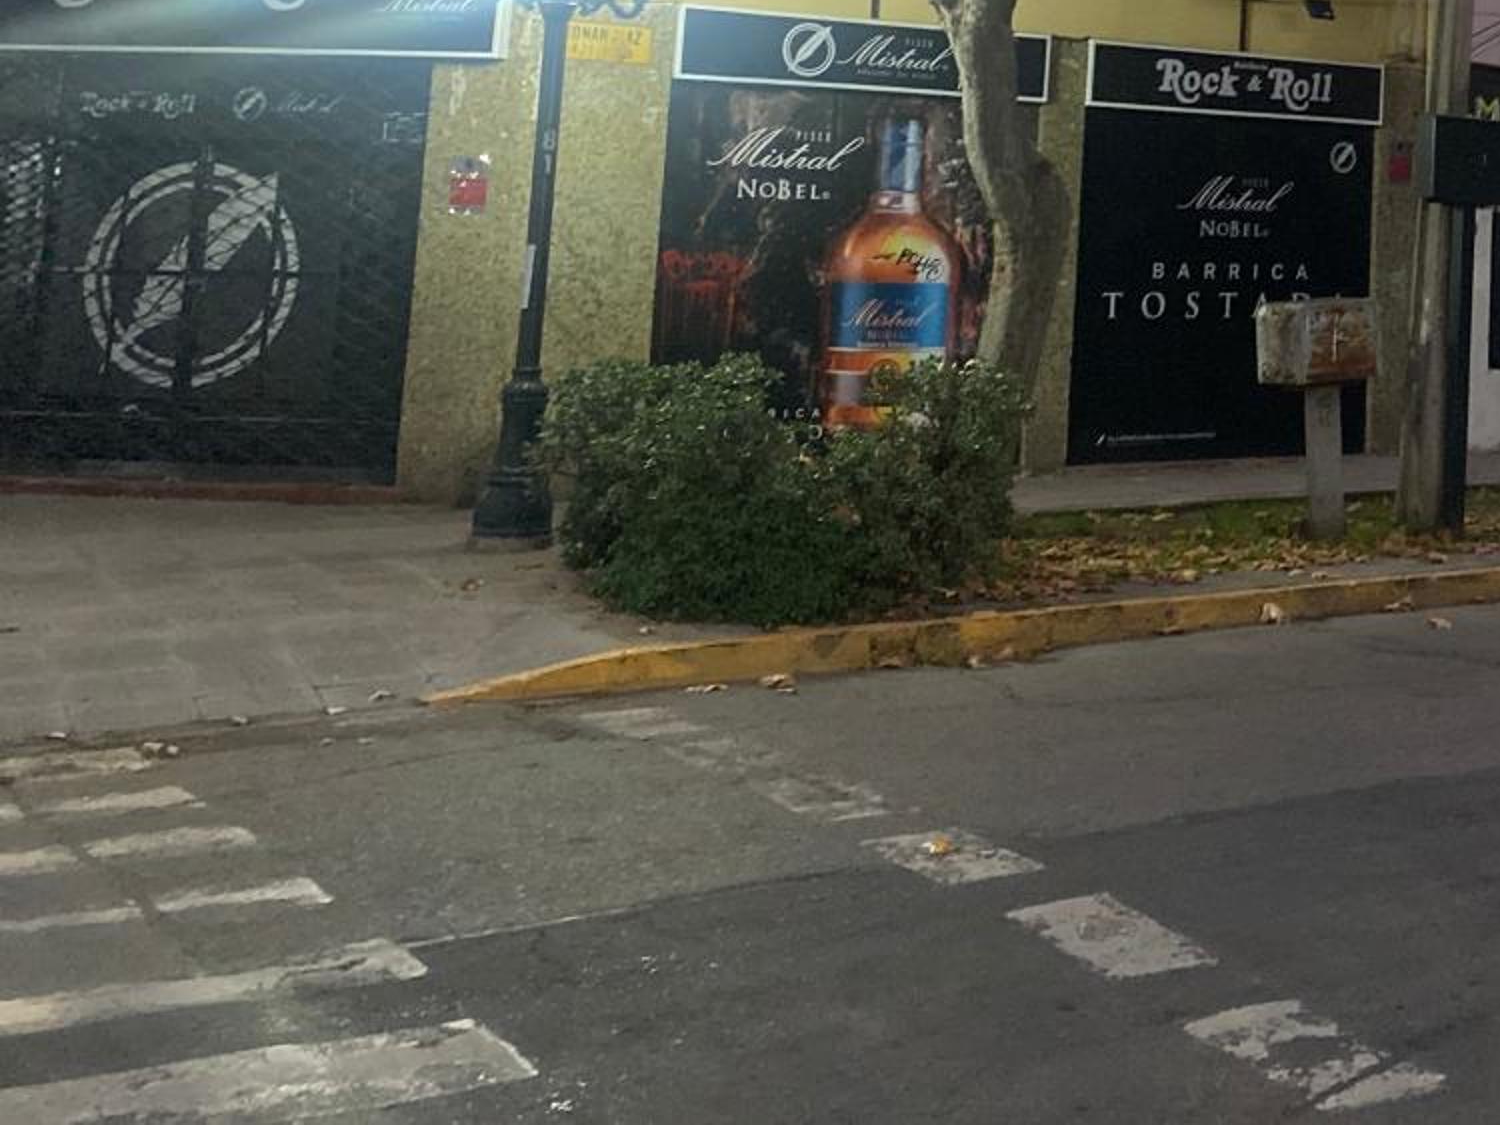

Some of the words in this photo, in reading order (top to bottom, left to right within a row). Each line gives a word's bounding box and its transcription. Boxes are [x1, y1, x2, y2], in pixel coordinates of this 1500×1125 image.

[836, 34, 953, 71] Mistral
[1156, 58, 1240, 105] Rock
[1247, 75, 1264, 92] &
[1268, 67, 1334, 112] Roll
[706, 126, 865, 171] Mistral
[1176, 175, 1295, 212] Mistral
[1152, 262, 1309, 280] BARRICA
[1102, 291, 1342, 320] TOSTA
